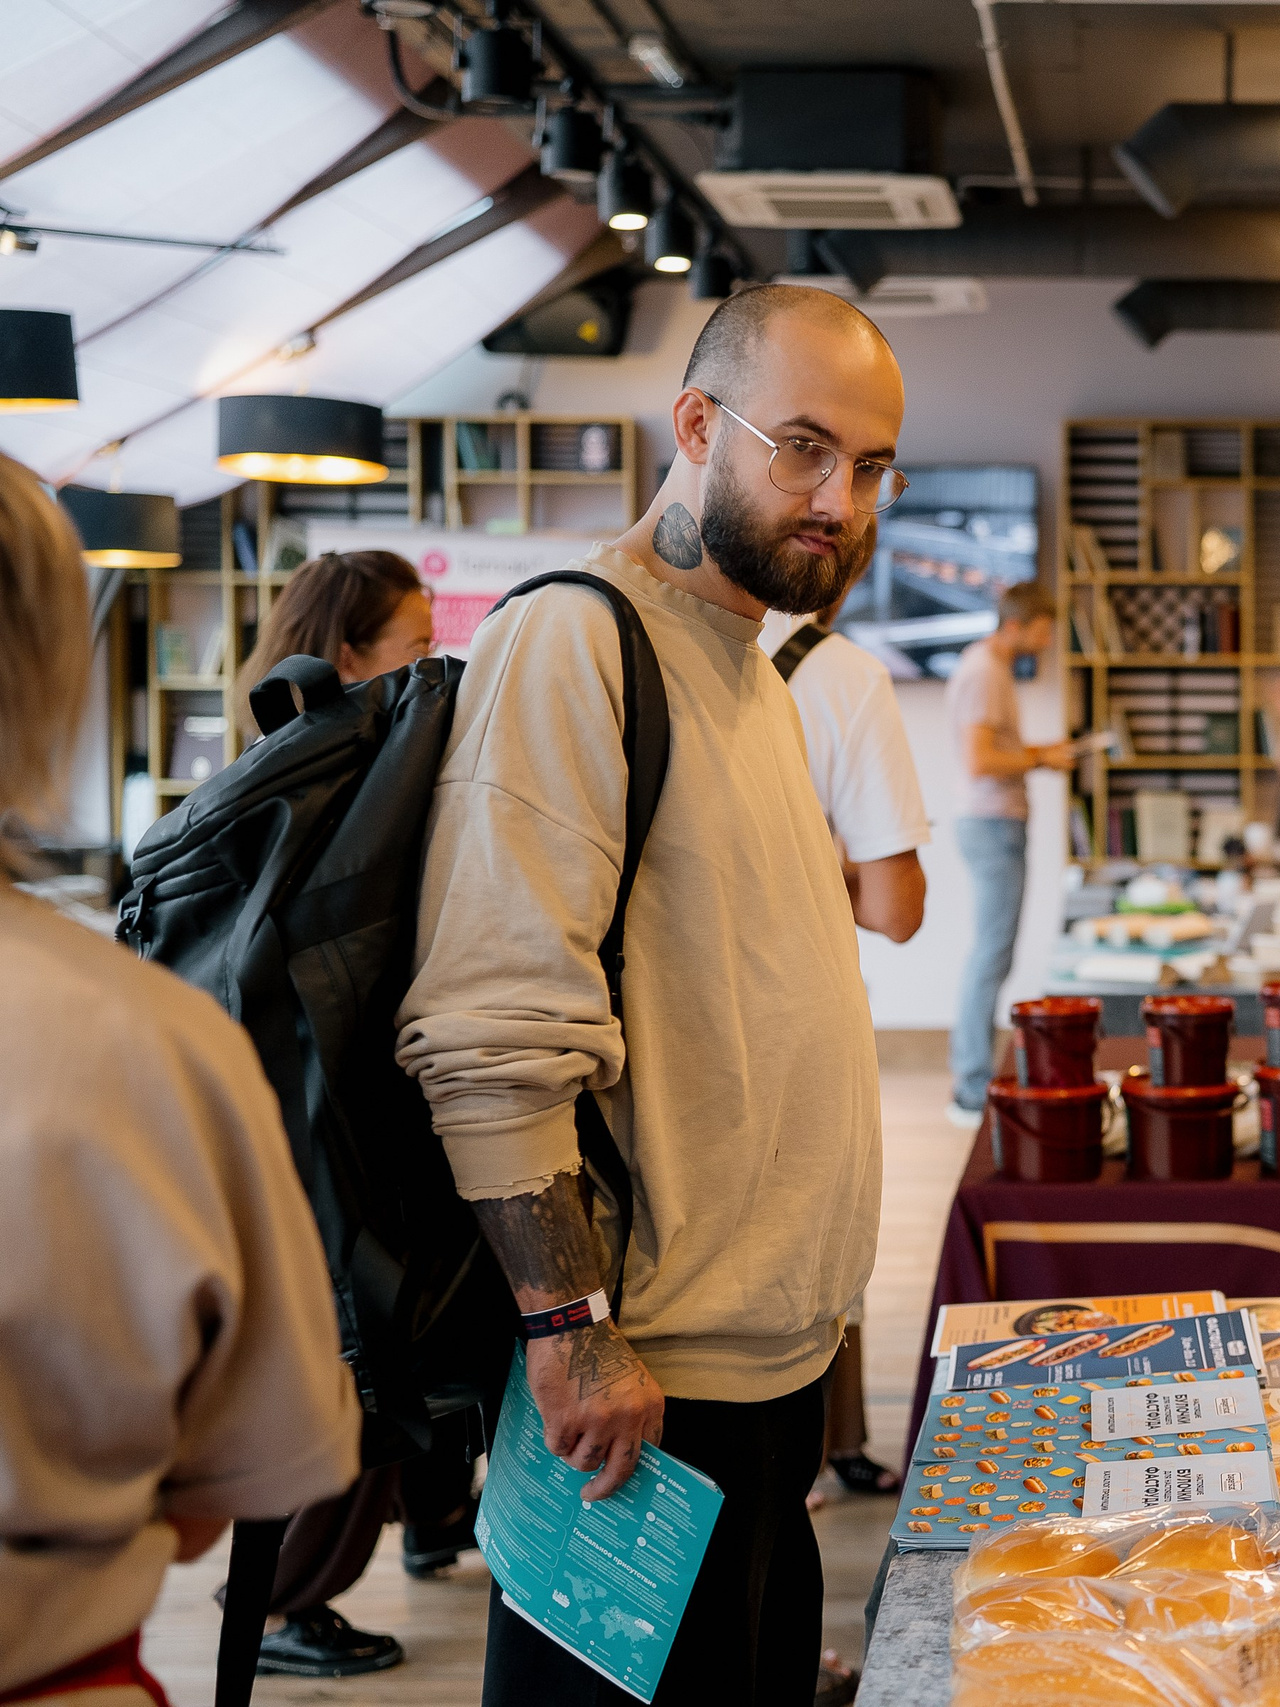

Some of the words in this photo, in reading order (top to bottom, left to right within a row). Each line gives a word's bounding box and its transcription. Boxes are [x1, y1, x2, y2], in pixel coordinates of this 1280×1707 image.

[1145, 1393, 1161, 1430] ФАСТФУДА
[1174, 1394, 1191, 1424] БУЛОЧКИ
[552, 1470, 565, 1482] 200
[666, 1477, 688, 1495] нами:
[1142, 1467, 1159, 1507] ФАСТФУДА
[1176, 1469, 1192, 1502] БУЛОЧКИ
[572, 1526, 613, 1559] Глобальное
[611, 1555, 657, 1589] присутствие
